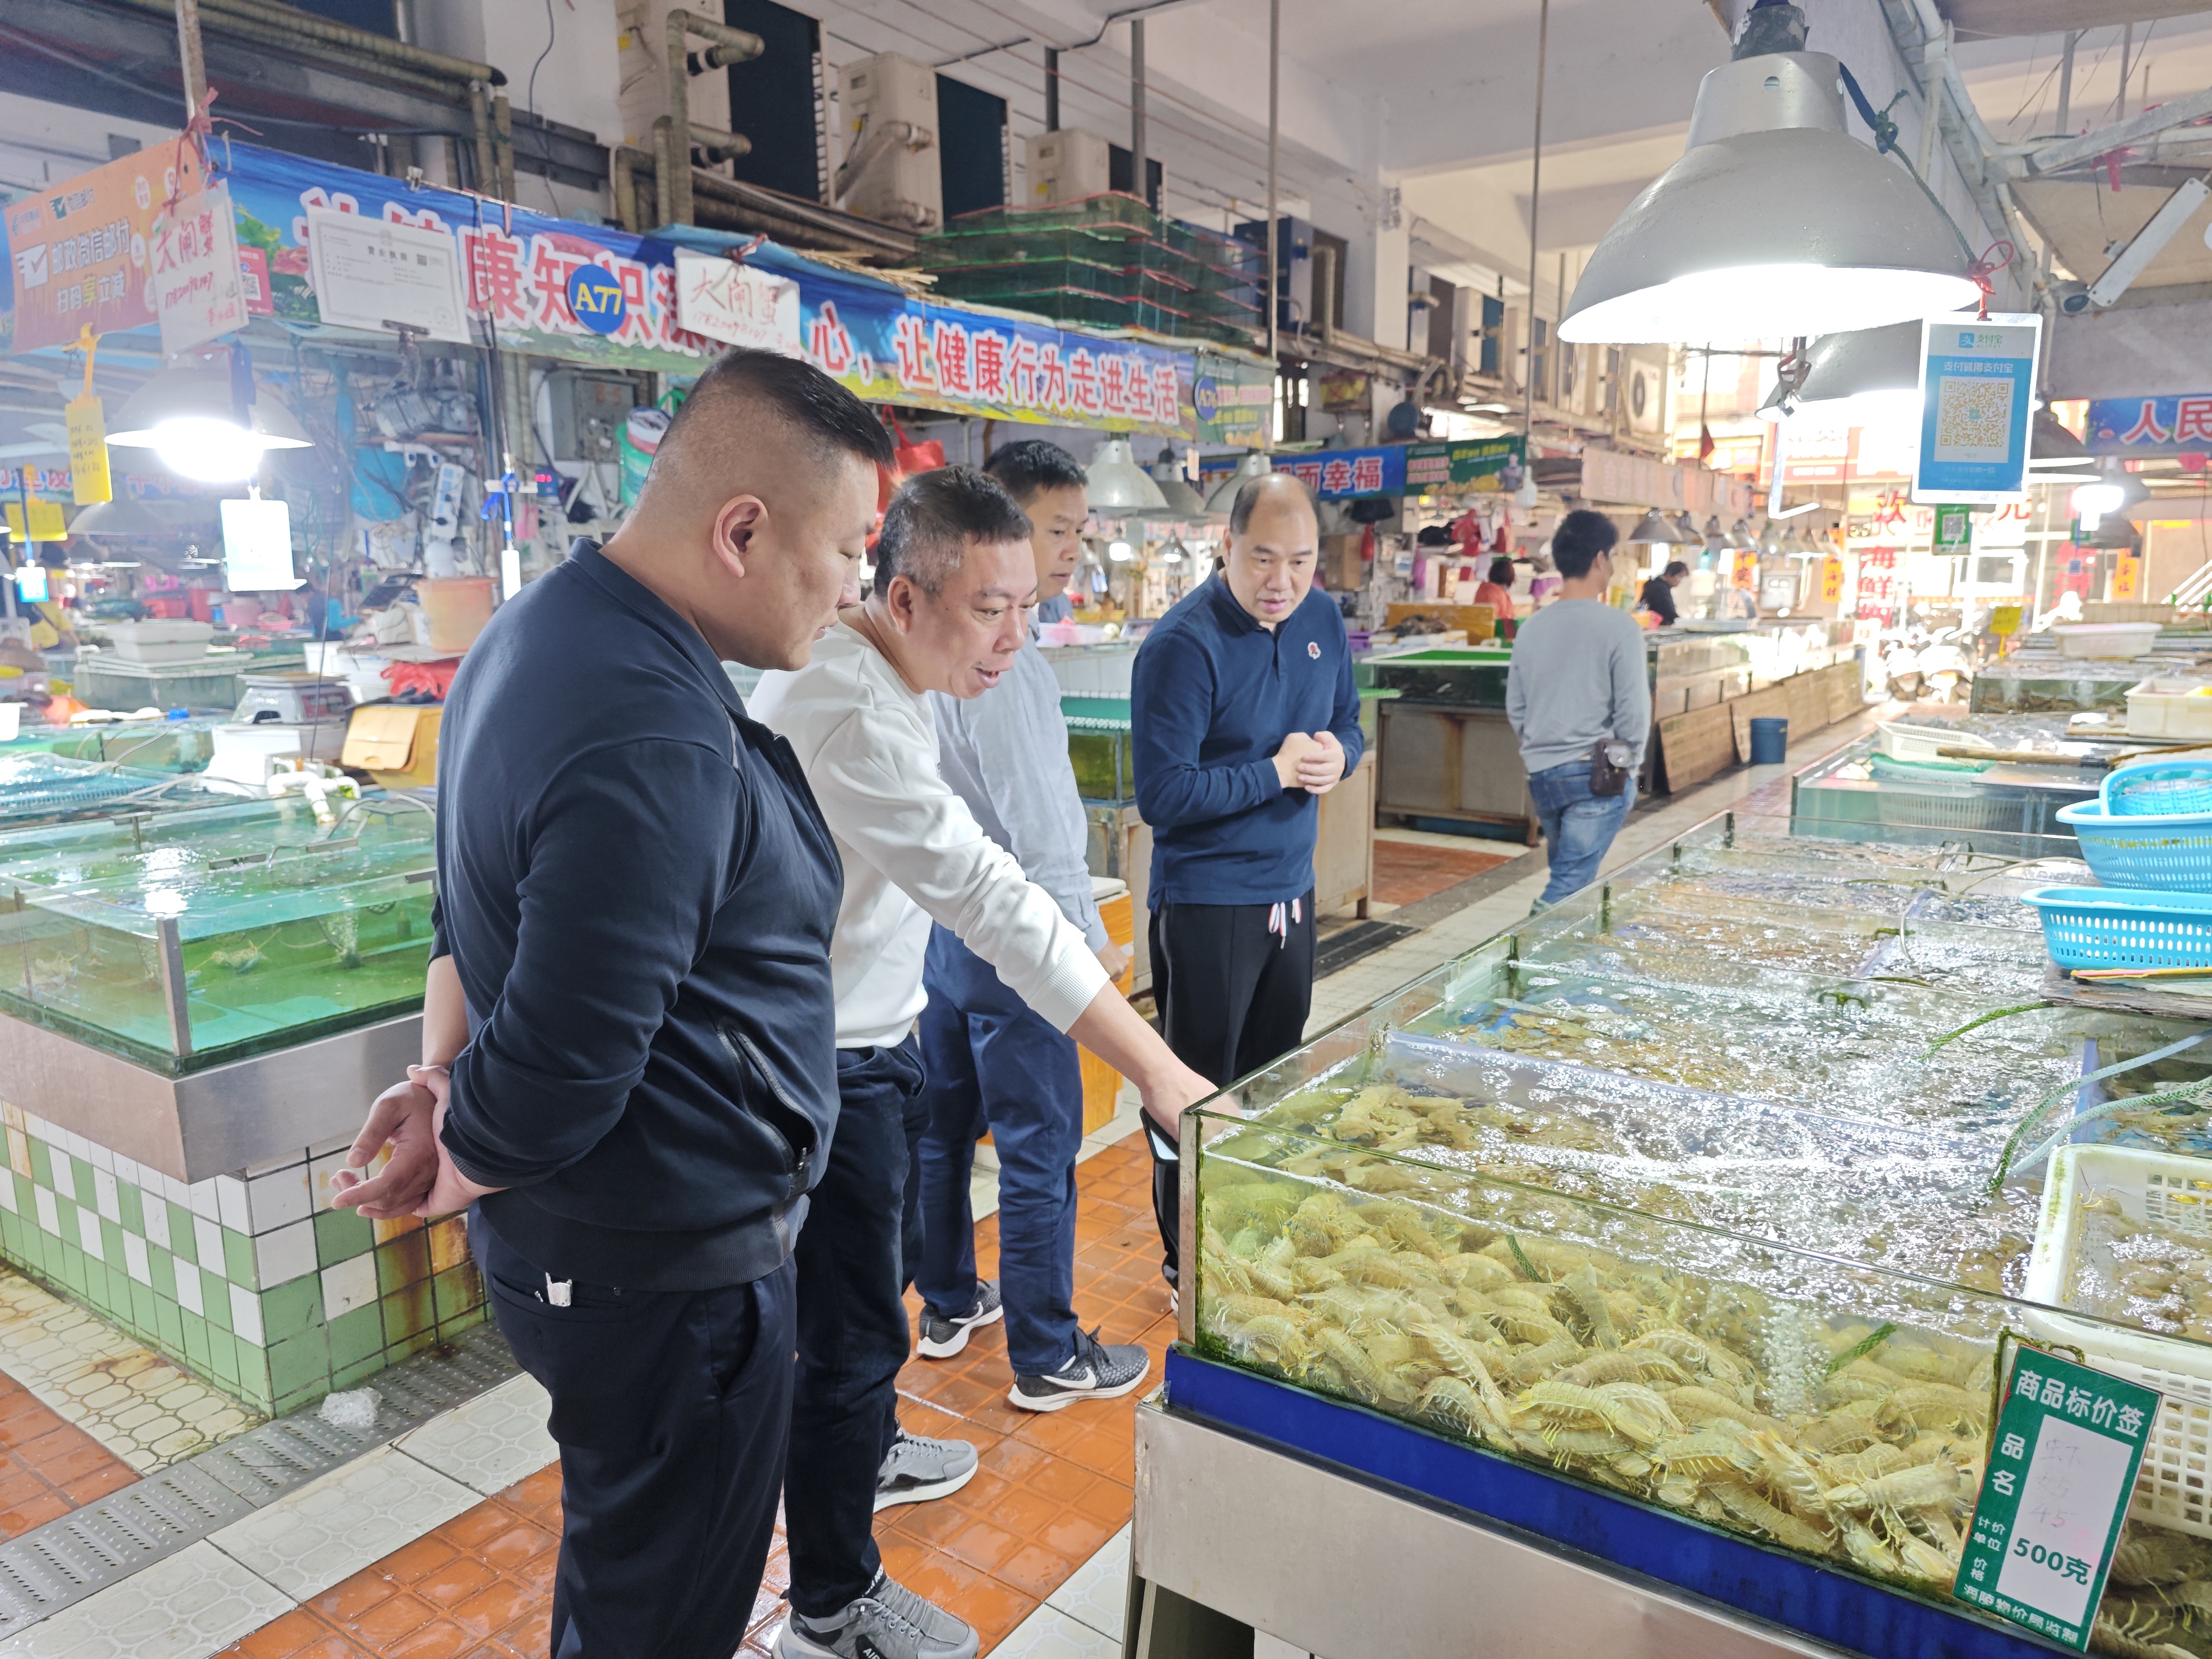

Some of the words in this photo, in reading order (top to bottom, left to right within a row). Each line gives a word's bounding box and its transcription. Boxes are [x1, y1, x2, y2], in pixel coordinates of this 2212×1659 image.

[52, 217, 130, 276] 邮政微信邮付
[57, 269, 125, 314] 扫码享立减
[575, 282, 623, 315] A77
[690, 267, 780, 326] 大闸蟹
[1977, 334, 2003, 344] 支付宝
[1944, 361, 2014, 374] 支付就用支付宝
[2120, 396, 2212, 445] 人民
[1271, 456, 1385, 494] 而幸福
[2015, 1370, 2146, 1438] 商品标价签
[1992, 1432, 2025, 1496] 品名
[1973, 1532, 2001, 1551] 单位
[1978, 1515, 2006, 1535] 计价
[1971, 1557, 1988, 1582] 价格
[2013, 1537, 2092, 1586] 500克
[1964, 1583, 2078, 1644] 海陵物价局监制
